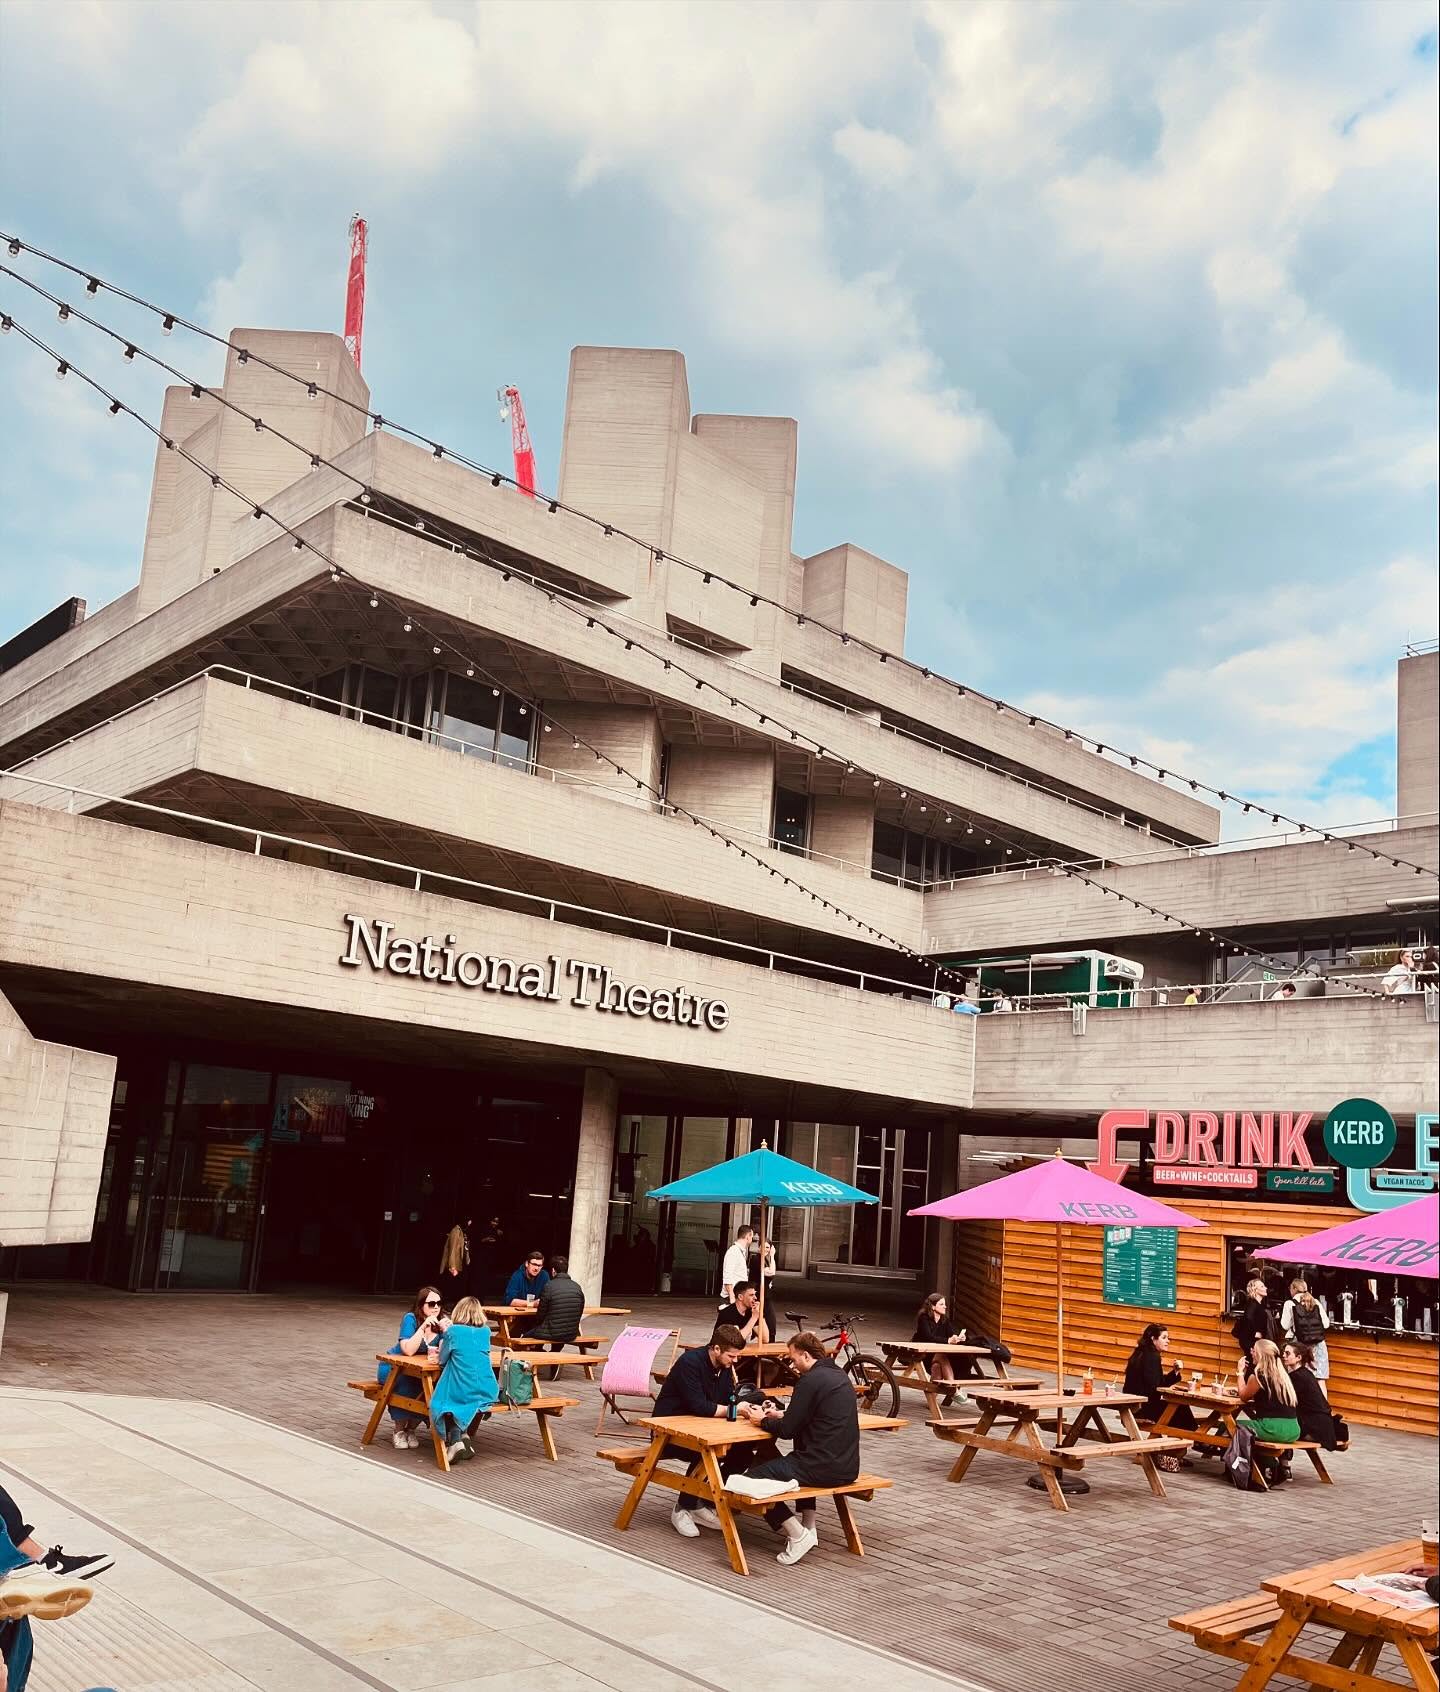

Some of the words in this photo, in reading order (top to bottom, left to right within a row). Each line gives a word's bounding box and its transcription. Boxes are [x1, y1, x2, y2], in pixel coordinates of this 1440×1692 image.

[340, 913, 561, 1000] National
[566, 957, 730, 1031] Theatre
[1154, 1111, 1315, 1168] DRINK
[1333, 1120, 1384, 1144] KERB
[780, 1181, 844, 1195] KERB
[1273, 1175, 1293, 1187] Open
[1383, 1177, 1403, 1185] VEGAN
[1405, 1178, 1425, 1186] TACOS
[1059, 1202, 1138, 1218] KERB
[1320, 1233, 1439, 1266] KERB
[623, 1329, 663, 1341] KERB
